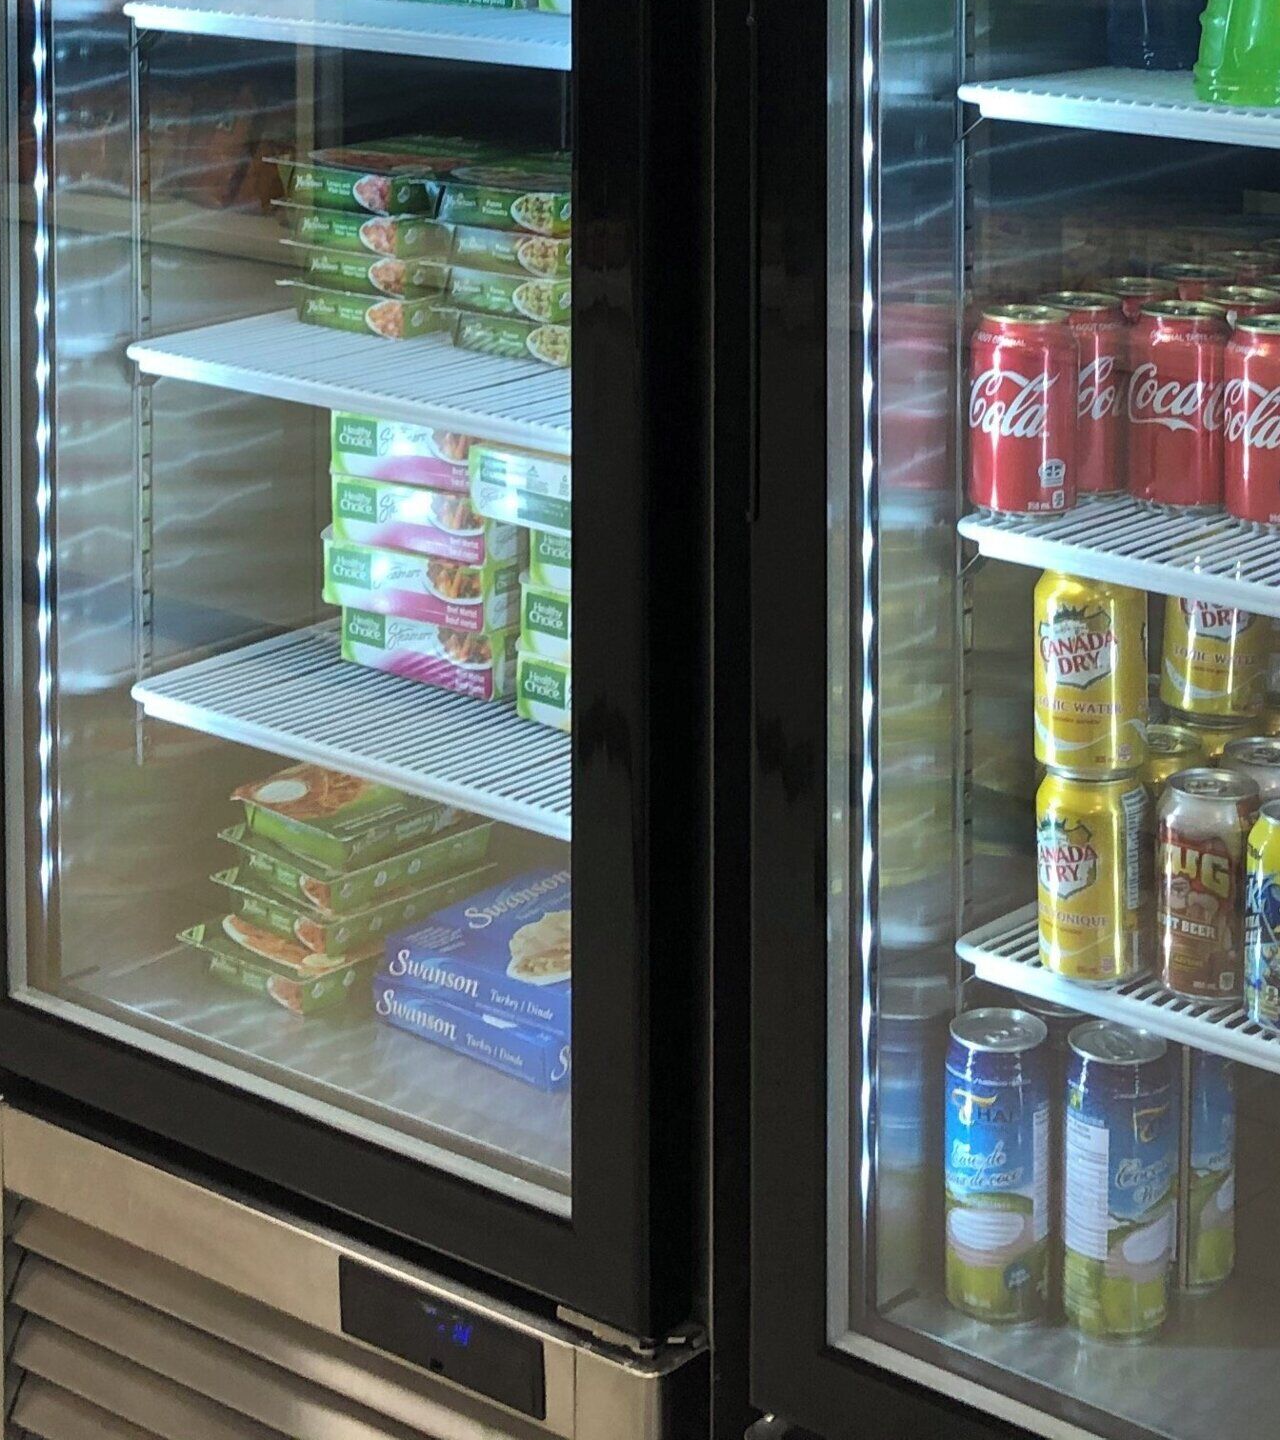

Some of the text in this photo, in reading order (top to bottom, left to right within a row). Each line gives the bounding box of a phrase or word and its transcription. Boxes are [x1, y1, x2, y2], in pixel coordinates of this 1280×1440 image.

[969, 370, 1060, 438] Cola
[339, 433, 374, 448] Choice
[343, 424, 372, 440] Healthy
[340, 499, 374, 515] Choice
[343, 490, 371, 506] Healthy
[332, 565, 368, 581] Choice
[529, 610, 565, 630] Choice
[532, 601, 563, 619] Healthy
[349, 623, 383, 641] Choice
[1040, 628, 1119, 663] CANADA
[1058, 653, 1101, 675] DRY
[525, 678, 560, 699] Choice
[529, 669, 559, 688] Healthy
[1074, 703, 1122, 715] WATER
[1038, 844, 1099, 864] ANADA
[464, 868, 571, 929] Swanson
[1182, 919, 1216, 939] BEER
[388, 949, 554, 1021] Swanson Turkey Dinde
[376, 989, 457, 1041] Swanson
[465, 1031, 494, 1055] Turkey
[499, 1045, 524, 1068] Dinde
